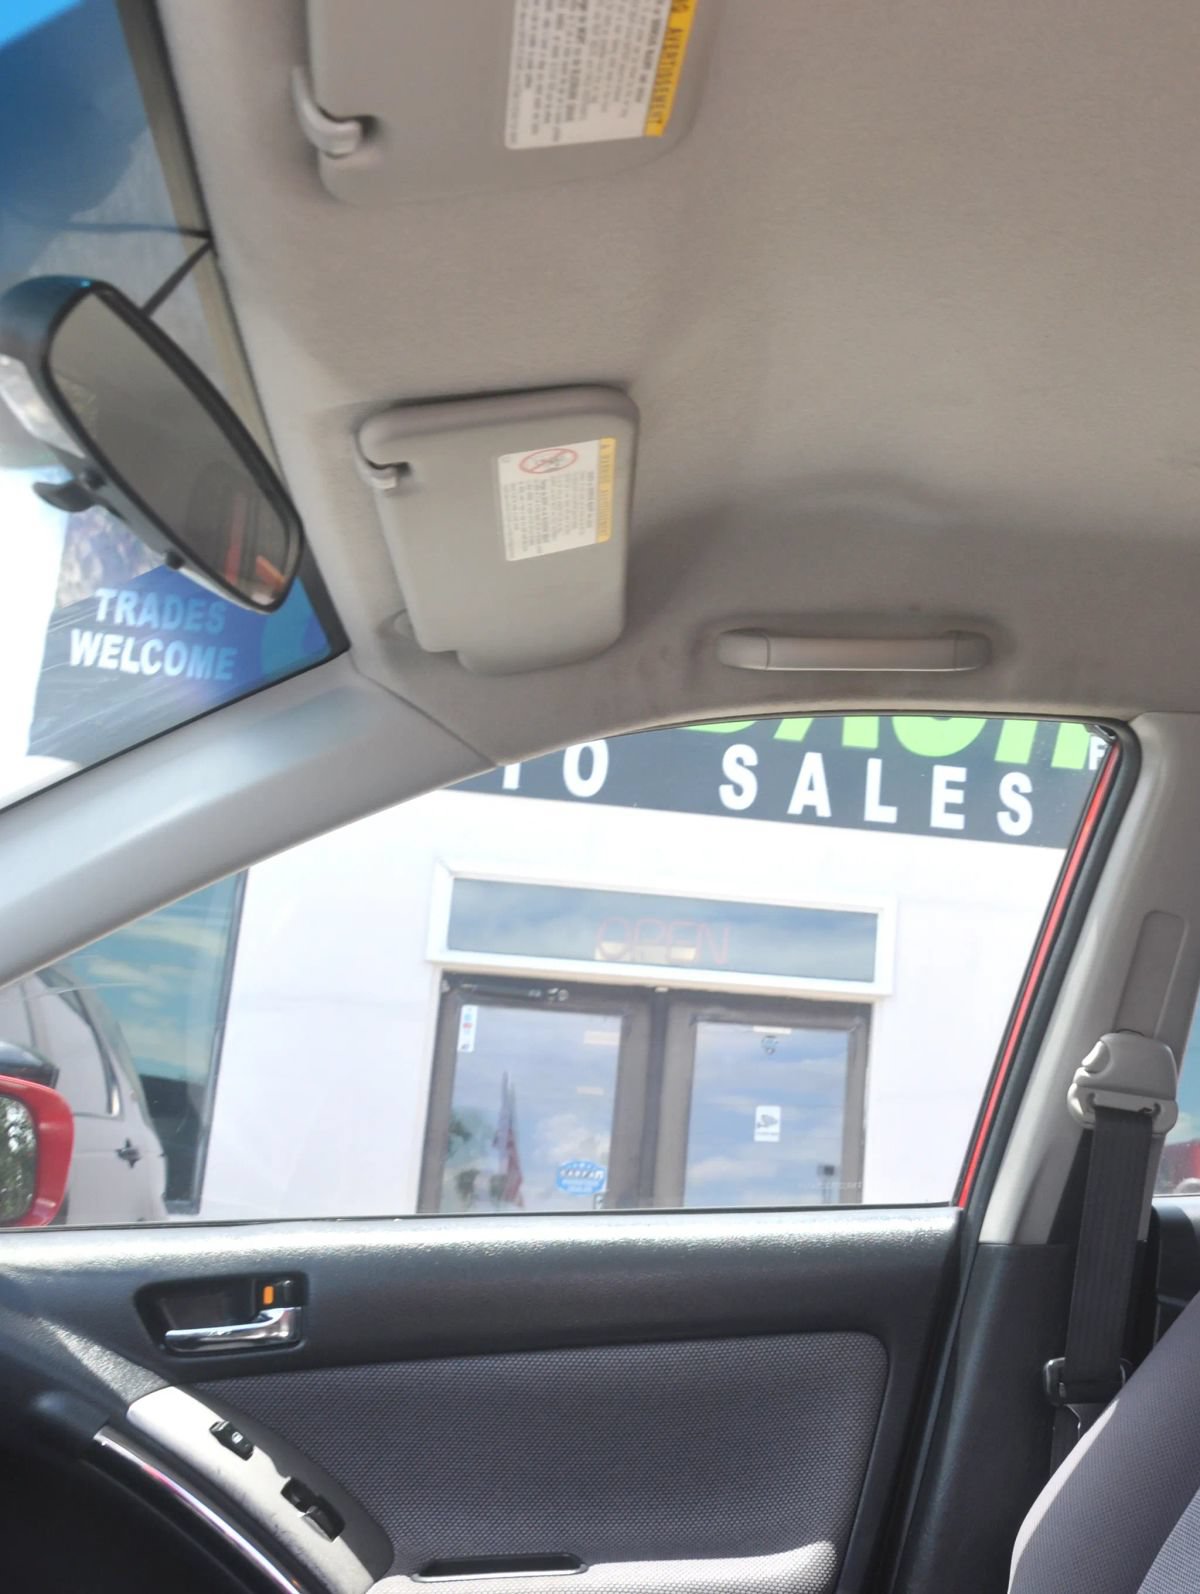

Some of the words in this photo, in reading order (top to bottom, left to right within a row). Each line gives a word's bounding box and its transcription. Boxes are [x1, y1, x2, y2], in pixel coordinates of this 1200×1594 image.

[95, 588, 227, 634] TRADES
[70, 628, 238, 680] WELCOME
[719, 743, 1034, 836] SALES
[596, 915, 730, 965] OPEN
